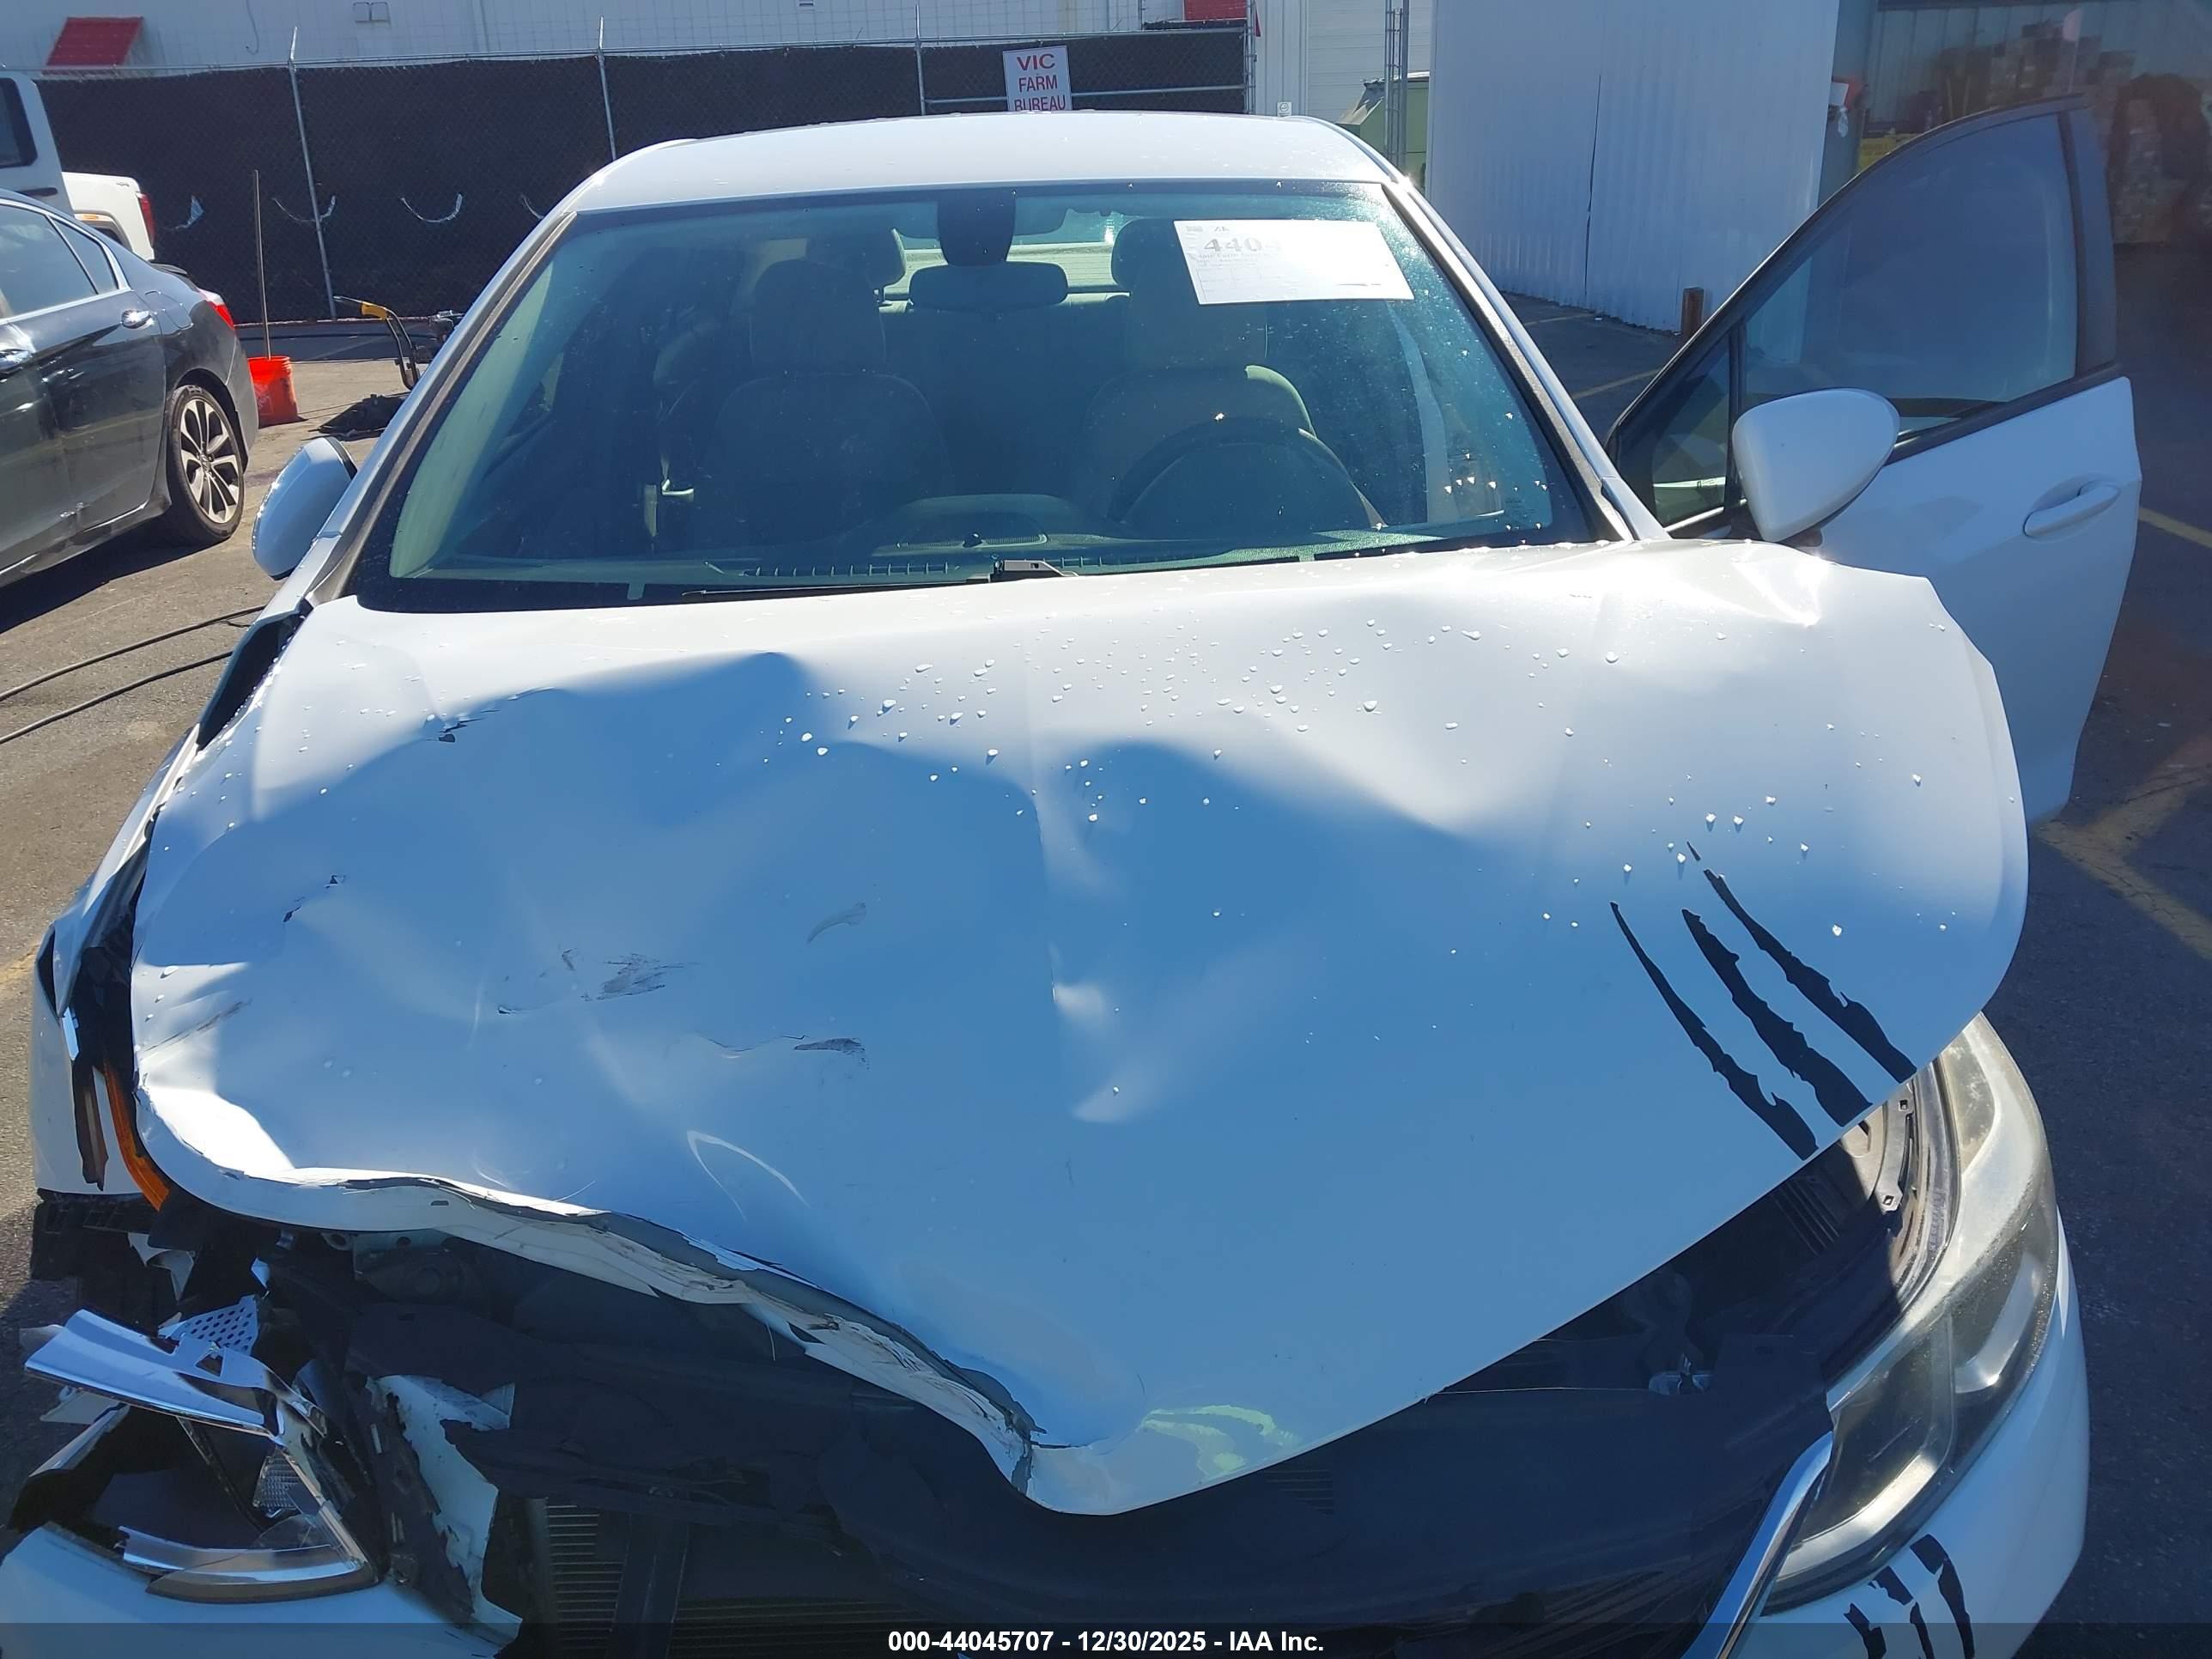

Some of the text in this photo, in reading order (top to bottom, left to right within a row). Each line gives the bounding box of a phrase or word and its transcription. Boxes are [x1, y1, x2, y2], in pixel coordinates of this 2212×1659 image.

[1017, 53, 1055, 71] VIC
[1018, 75, 1058, 93] FARM
[1014, 95, 1066, 112] BUREAU
